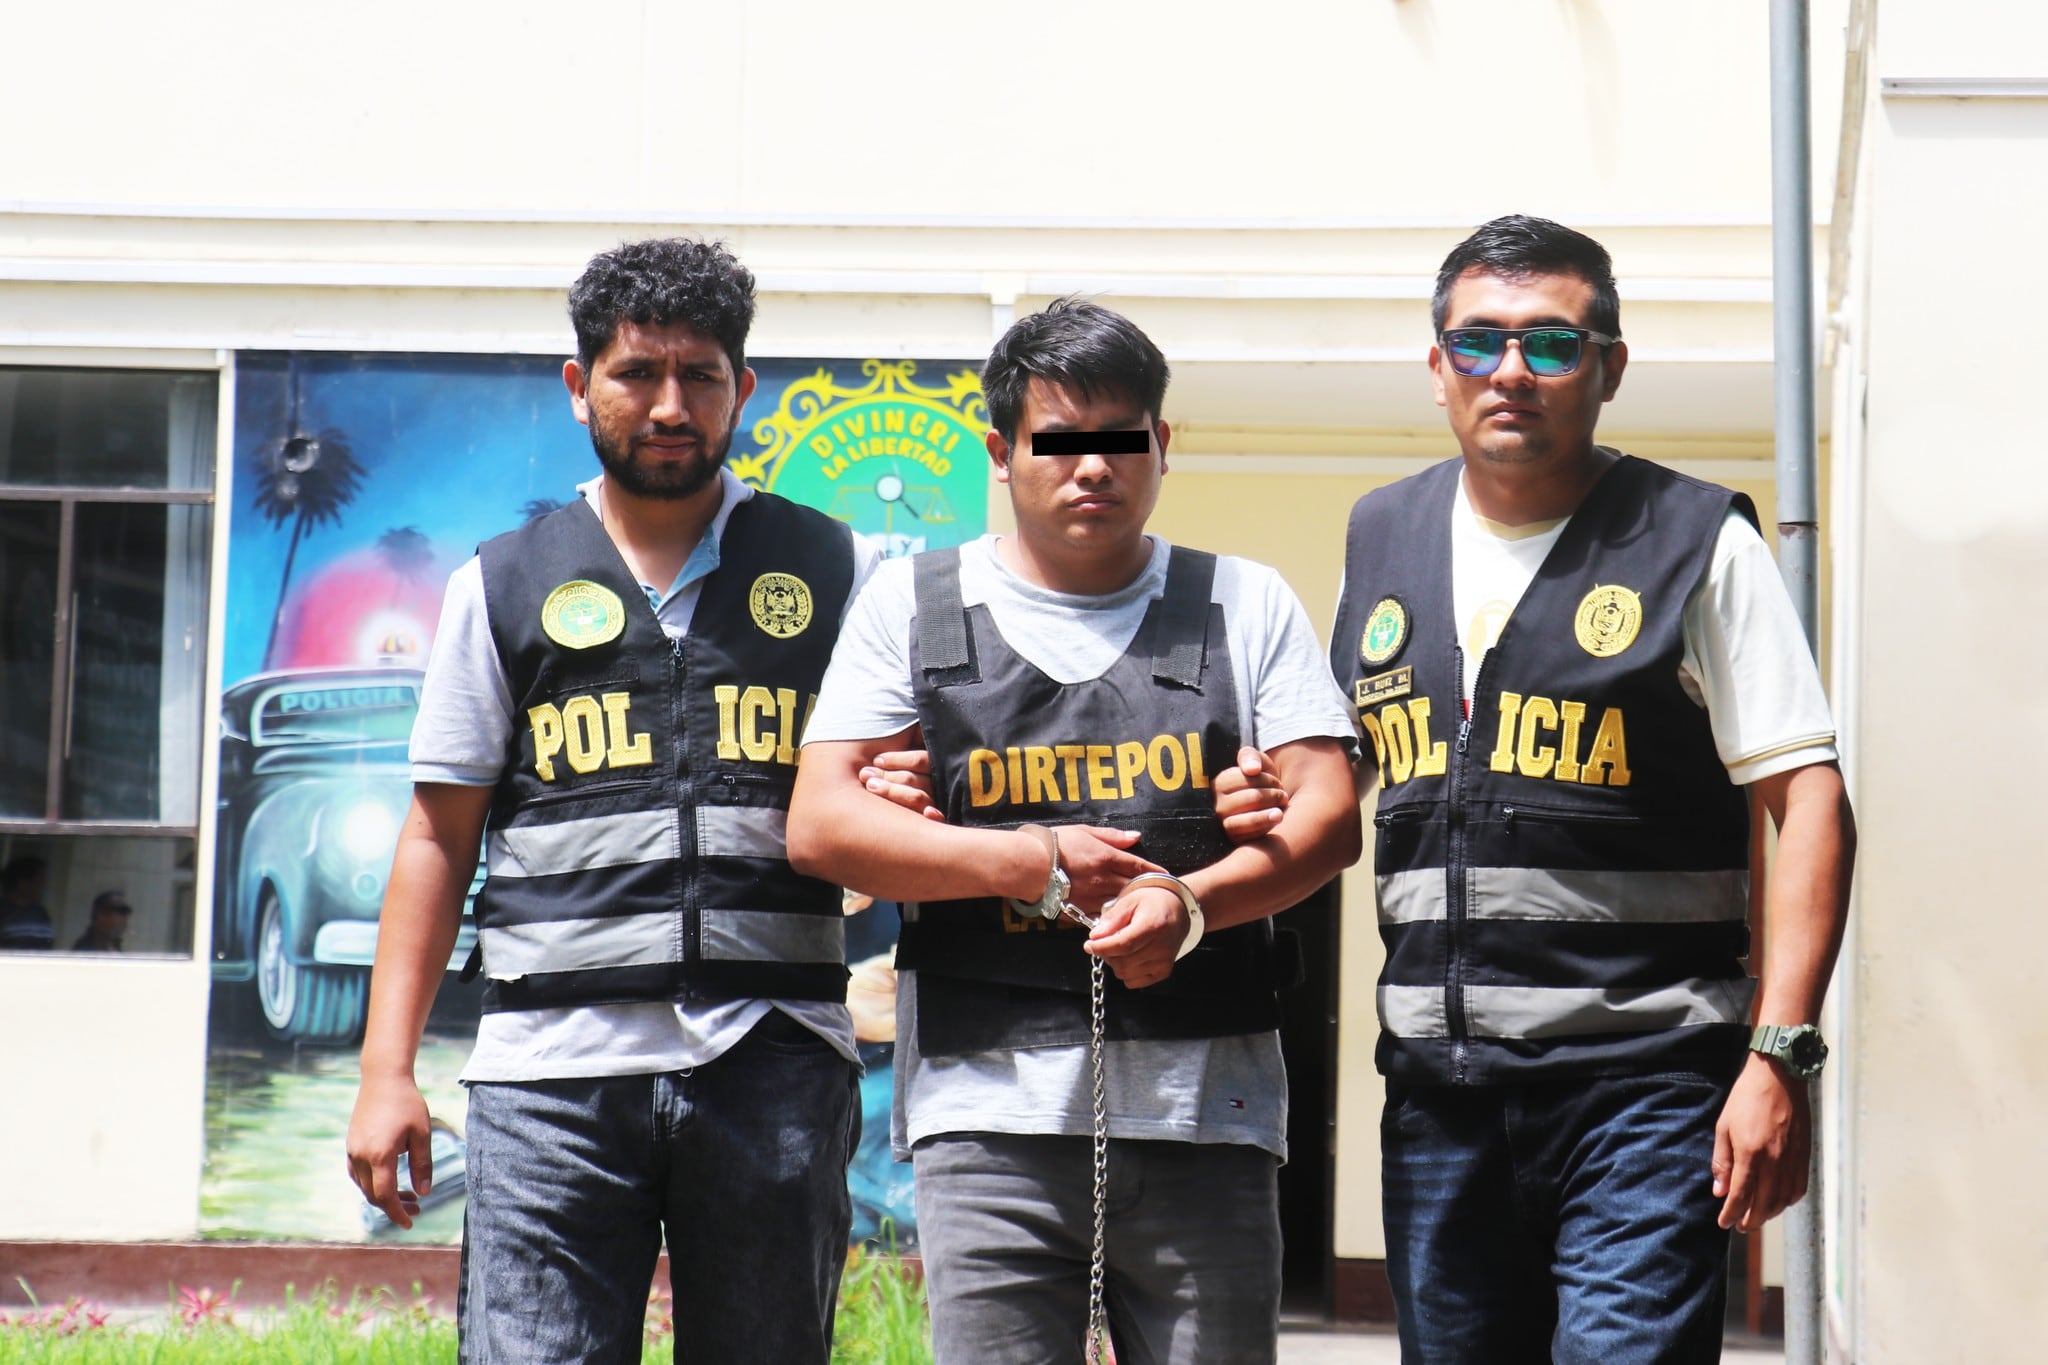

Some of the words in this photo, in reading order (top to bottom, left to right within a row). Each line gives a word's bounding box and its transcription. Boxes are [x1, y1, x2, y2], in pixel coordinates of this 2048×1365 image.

[810, 410, 959, 458] DIVINCRI
[820, 455, 850, 480] LA
[847, 437, 952, 477] LIBERTAD
[279, 686, 402, 714] POLICIA
[527, 692, 653, 782] POL
[1490, 691, 1631, 786] ICIA
[968, 732, 1210, 808] DIRTEPOL
